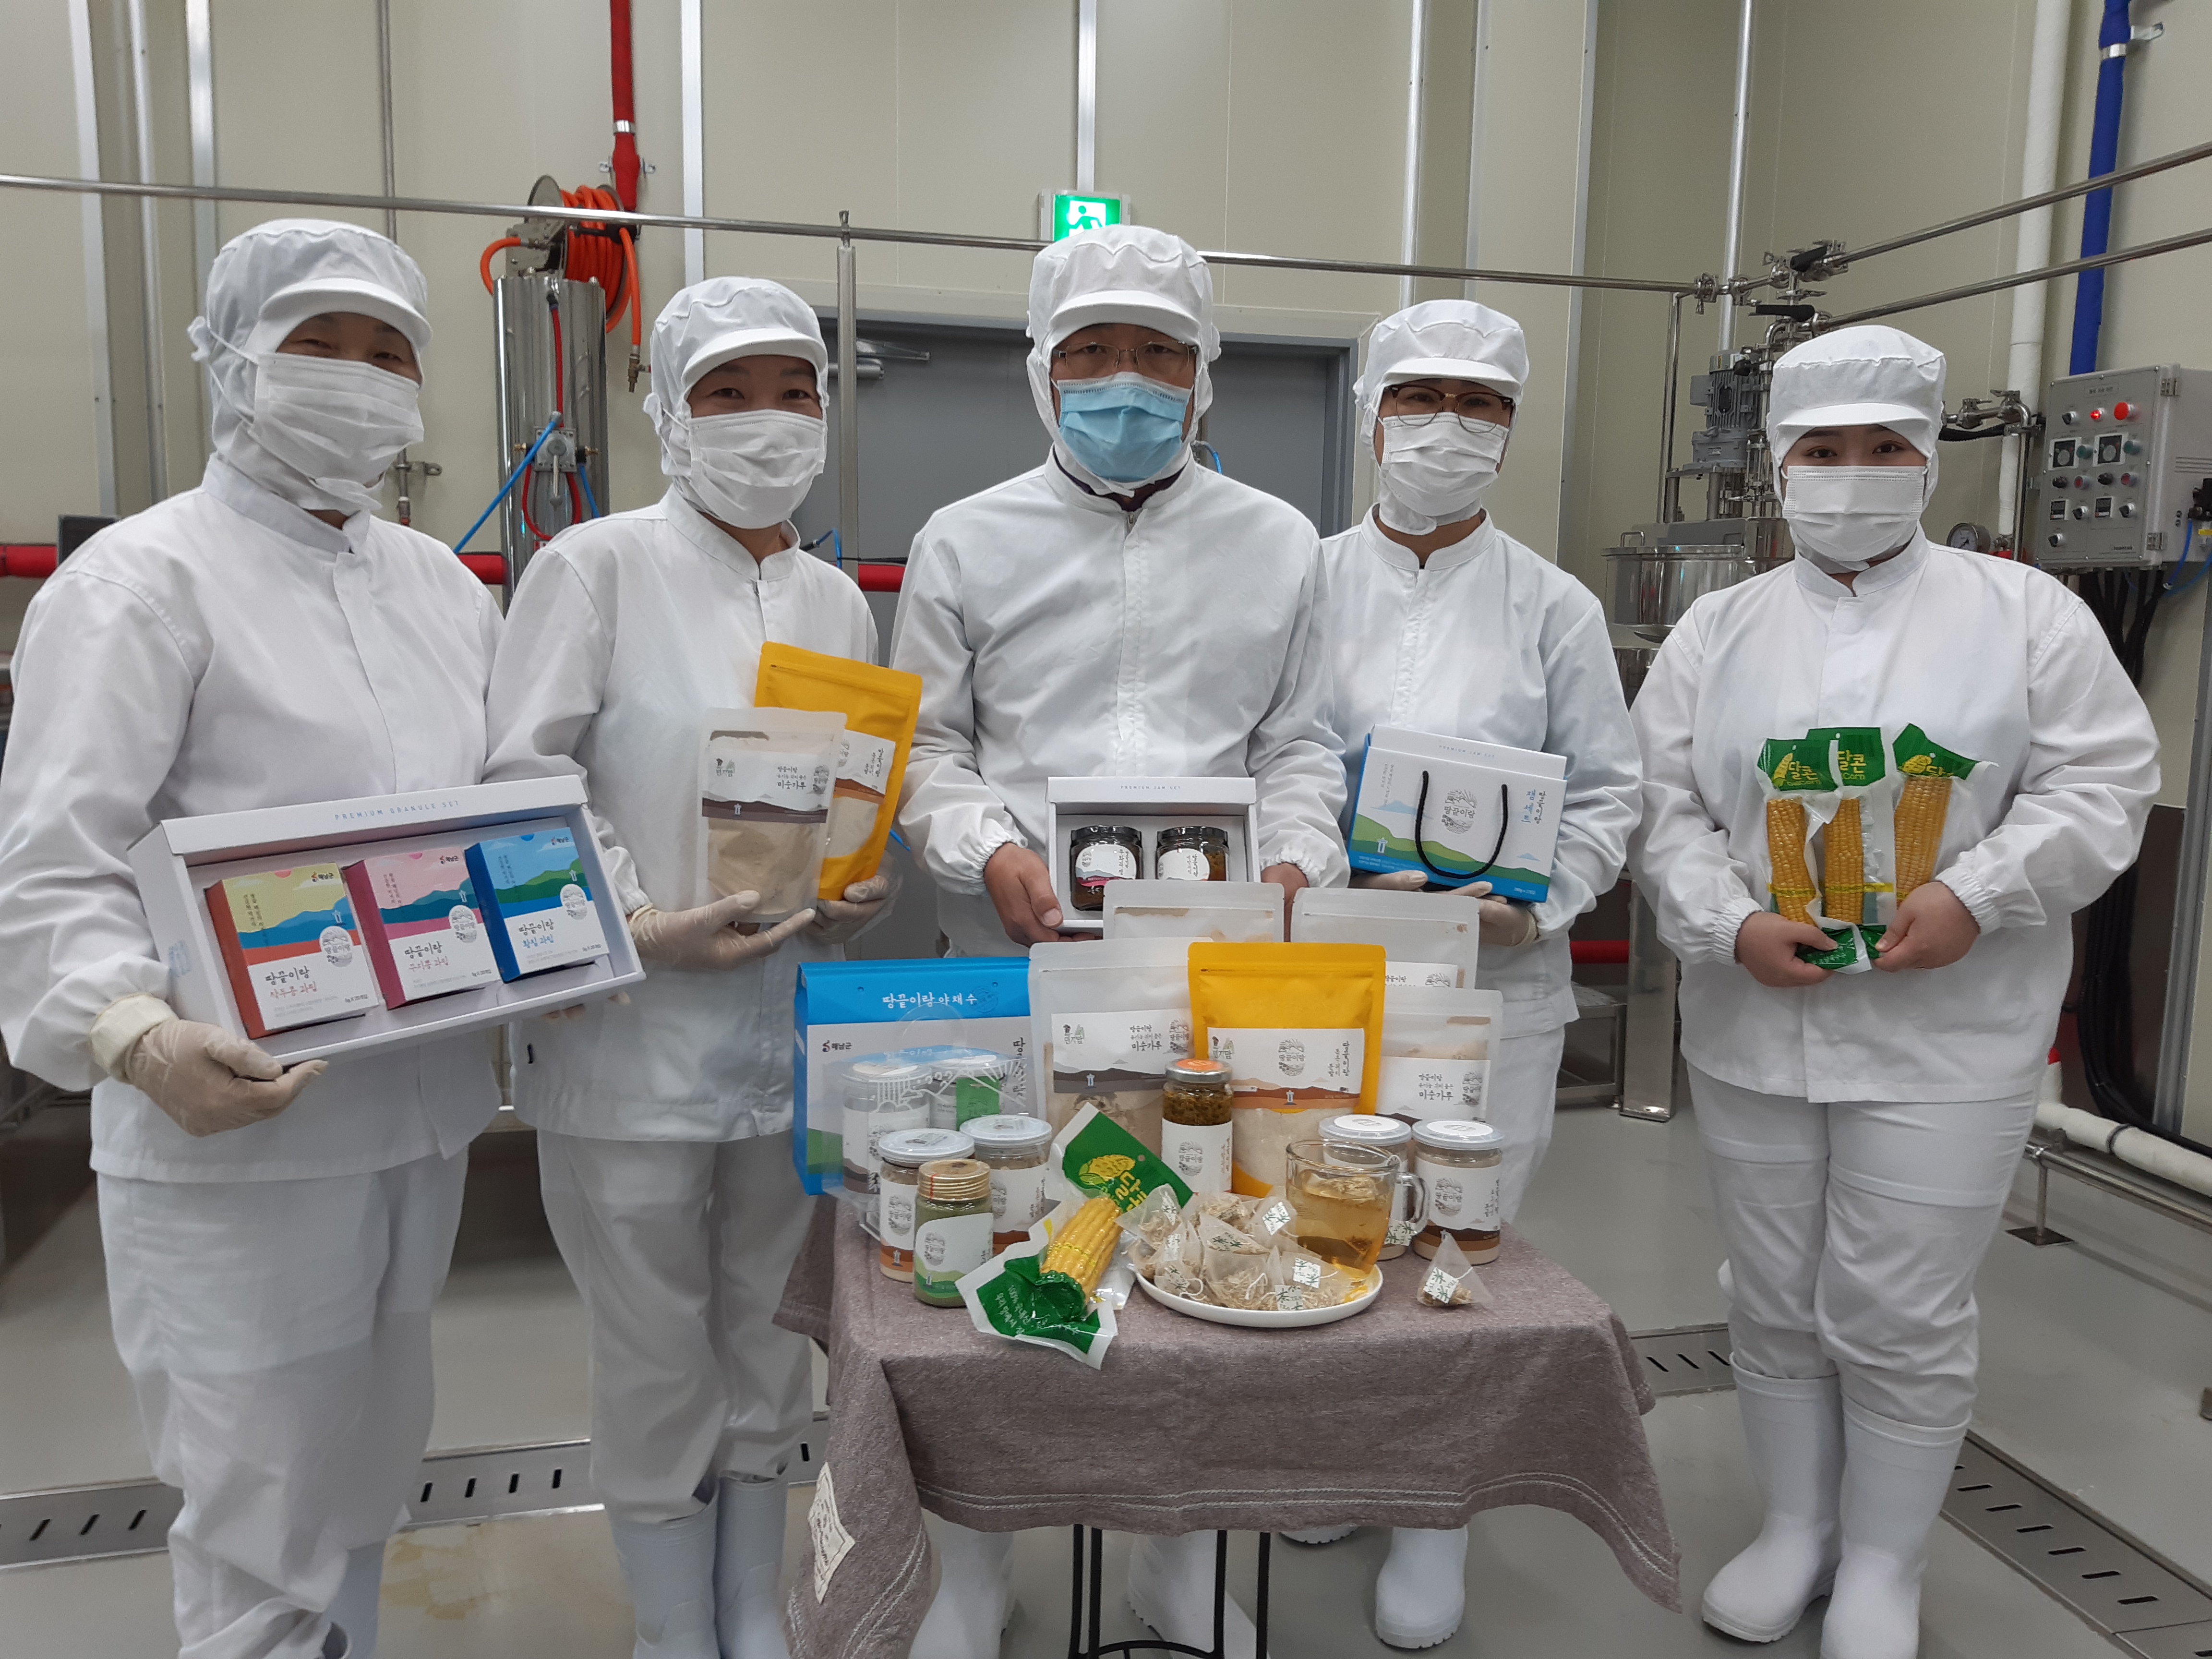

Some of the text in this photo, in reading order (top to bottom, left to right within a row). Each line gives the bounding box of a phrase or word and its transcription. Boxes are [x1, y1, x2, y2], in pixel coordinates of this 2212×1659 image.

[1837, 750, 1867, 773] 달콘
[1789, 761, 1818, 780] 달콘
[777, 779, 806, 790] 미숫가루
[335, 810, 383, 820] PREMIUM
[390, 803, 436, 814] GRANULE
[1444, 806, 1476, 819] 땅끝이랑
[1534, 791, 1547, 824] 땅끝이랑
[519, 918, 554, 936] 땅끝이랑
[540, 934, 554, 944] 과립
[405, 941, 443, 959] 땅끝이랑
[433, 956, 449, 966] 과립
[265, 966, 310, 985] 땅끝이랑
[299, 981, 317, 993] 과립
[883, 992, 935, 1009] 땅끝이랑
[1131, 1040, 1162, 1051] 미숫가루
[1342, 1041, 1350, 1077] 땅끝이랑
[1419, 1073, 1443, 1082] 땅끝이랑
[1419, 1089, 1454, 1101] 미숫가루
